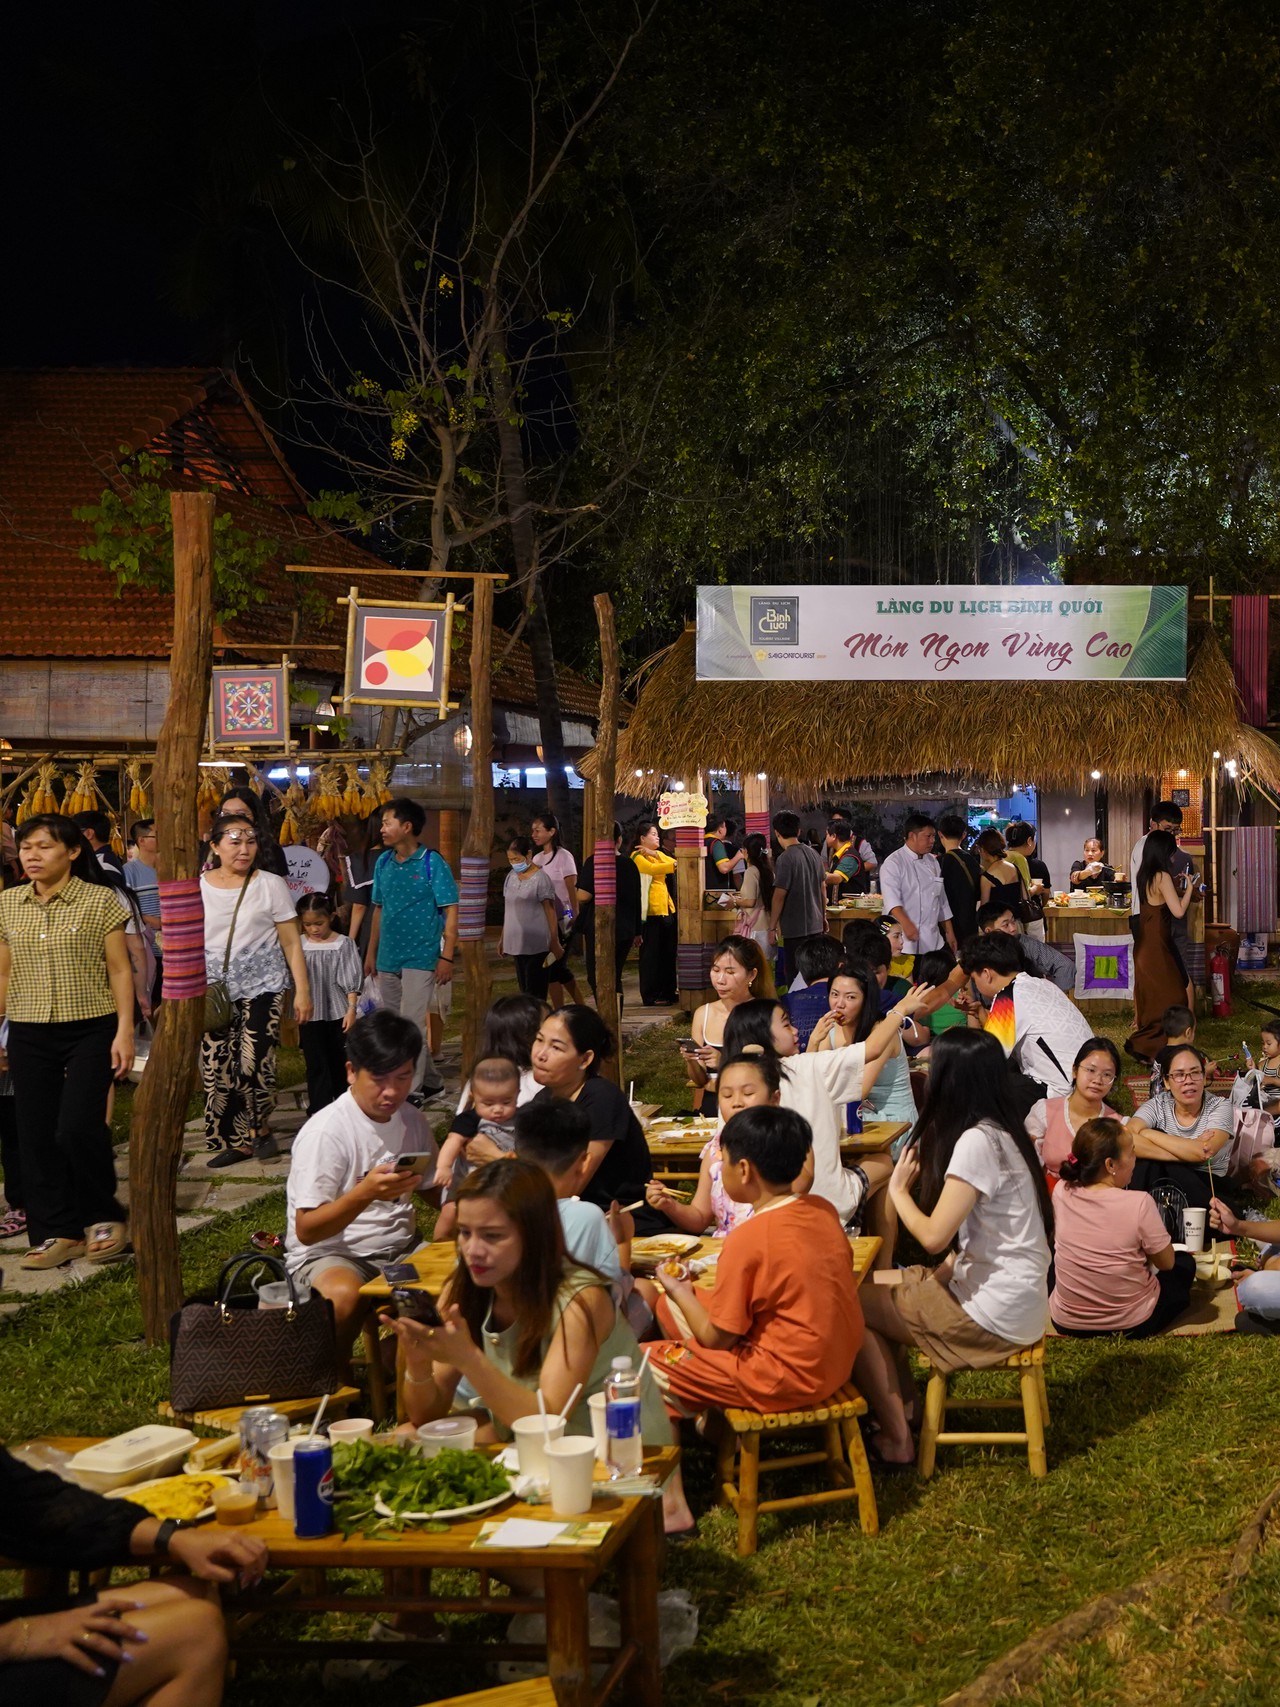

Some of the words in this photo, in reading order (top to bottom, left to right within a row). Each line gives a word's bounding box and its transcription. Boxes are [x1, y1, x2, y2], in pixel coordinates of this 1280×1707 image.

[877, 597, 924, 614] LÀNG
[930, 601, 954, 614] DU
[960, 600, 1003, 616] LỊCH
[1007, 598, 1053, 614] BÌNH
[843, 632, 910, 658] Món
[920, 632, 990, 671] Ngon
[1001, 631, 1074, 671] Vùng
[1086, 631, 1133, 658] Cao
[657, 806, 671, 816] 10
